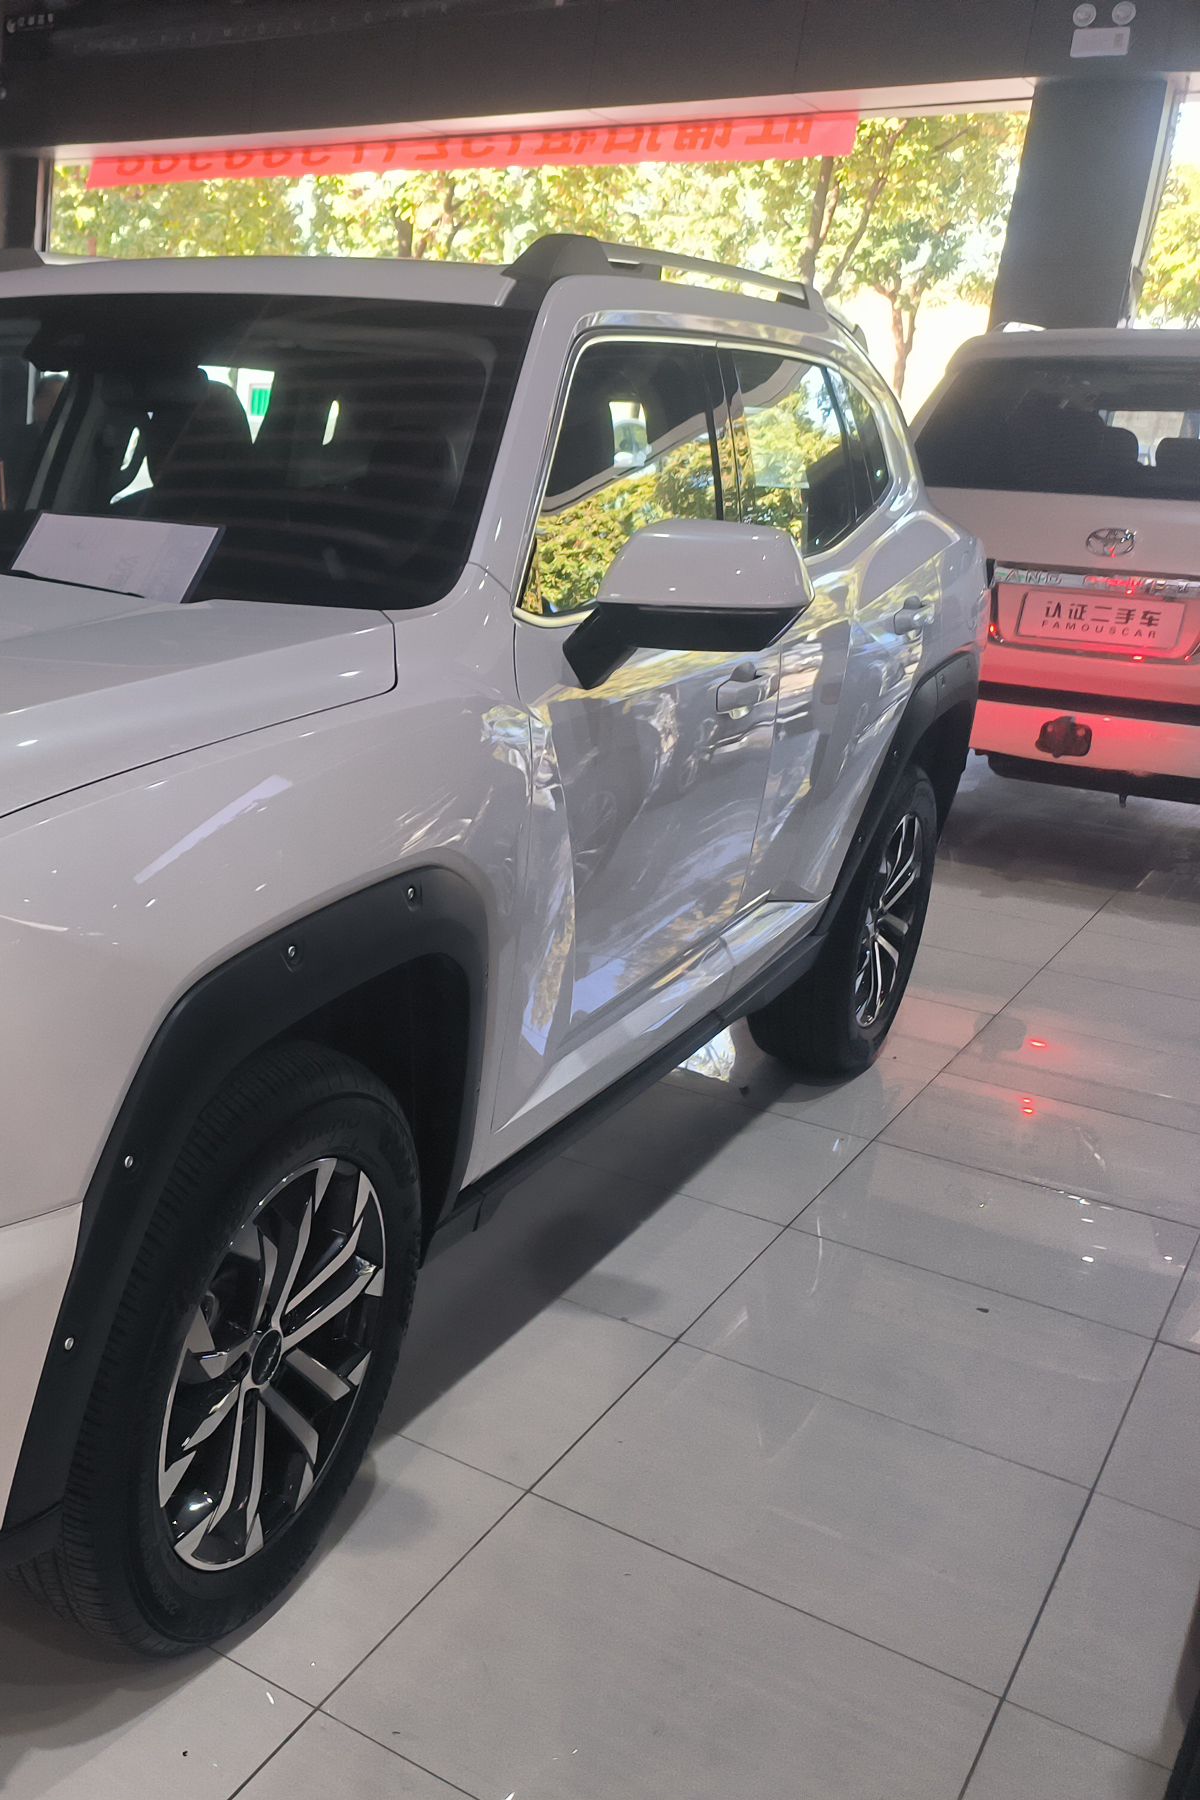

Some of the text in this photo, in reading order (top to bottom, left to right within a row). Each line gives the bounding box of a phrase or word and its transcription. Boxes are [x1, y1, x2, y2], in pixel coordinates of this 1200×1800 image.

[1044, 600, 1162, 627] 认证二手车
